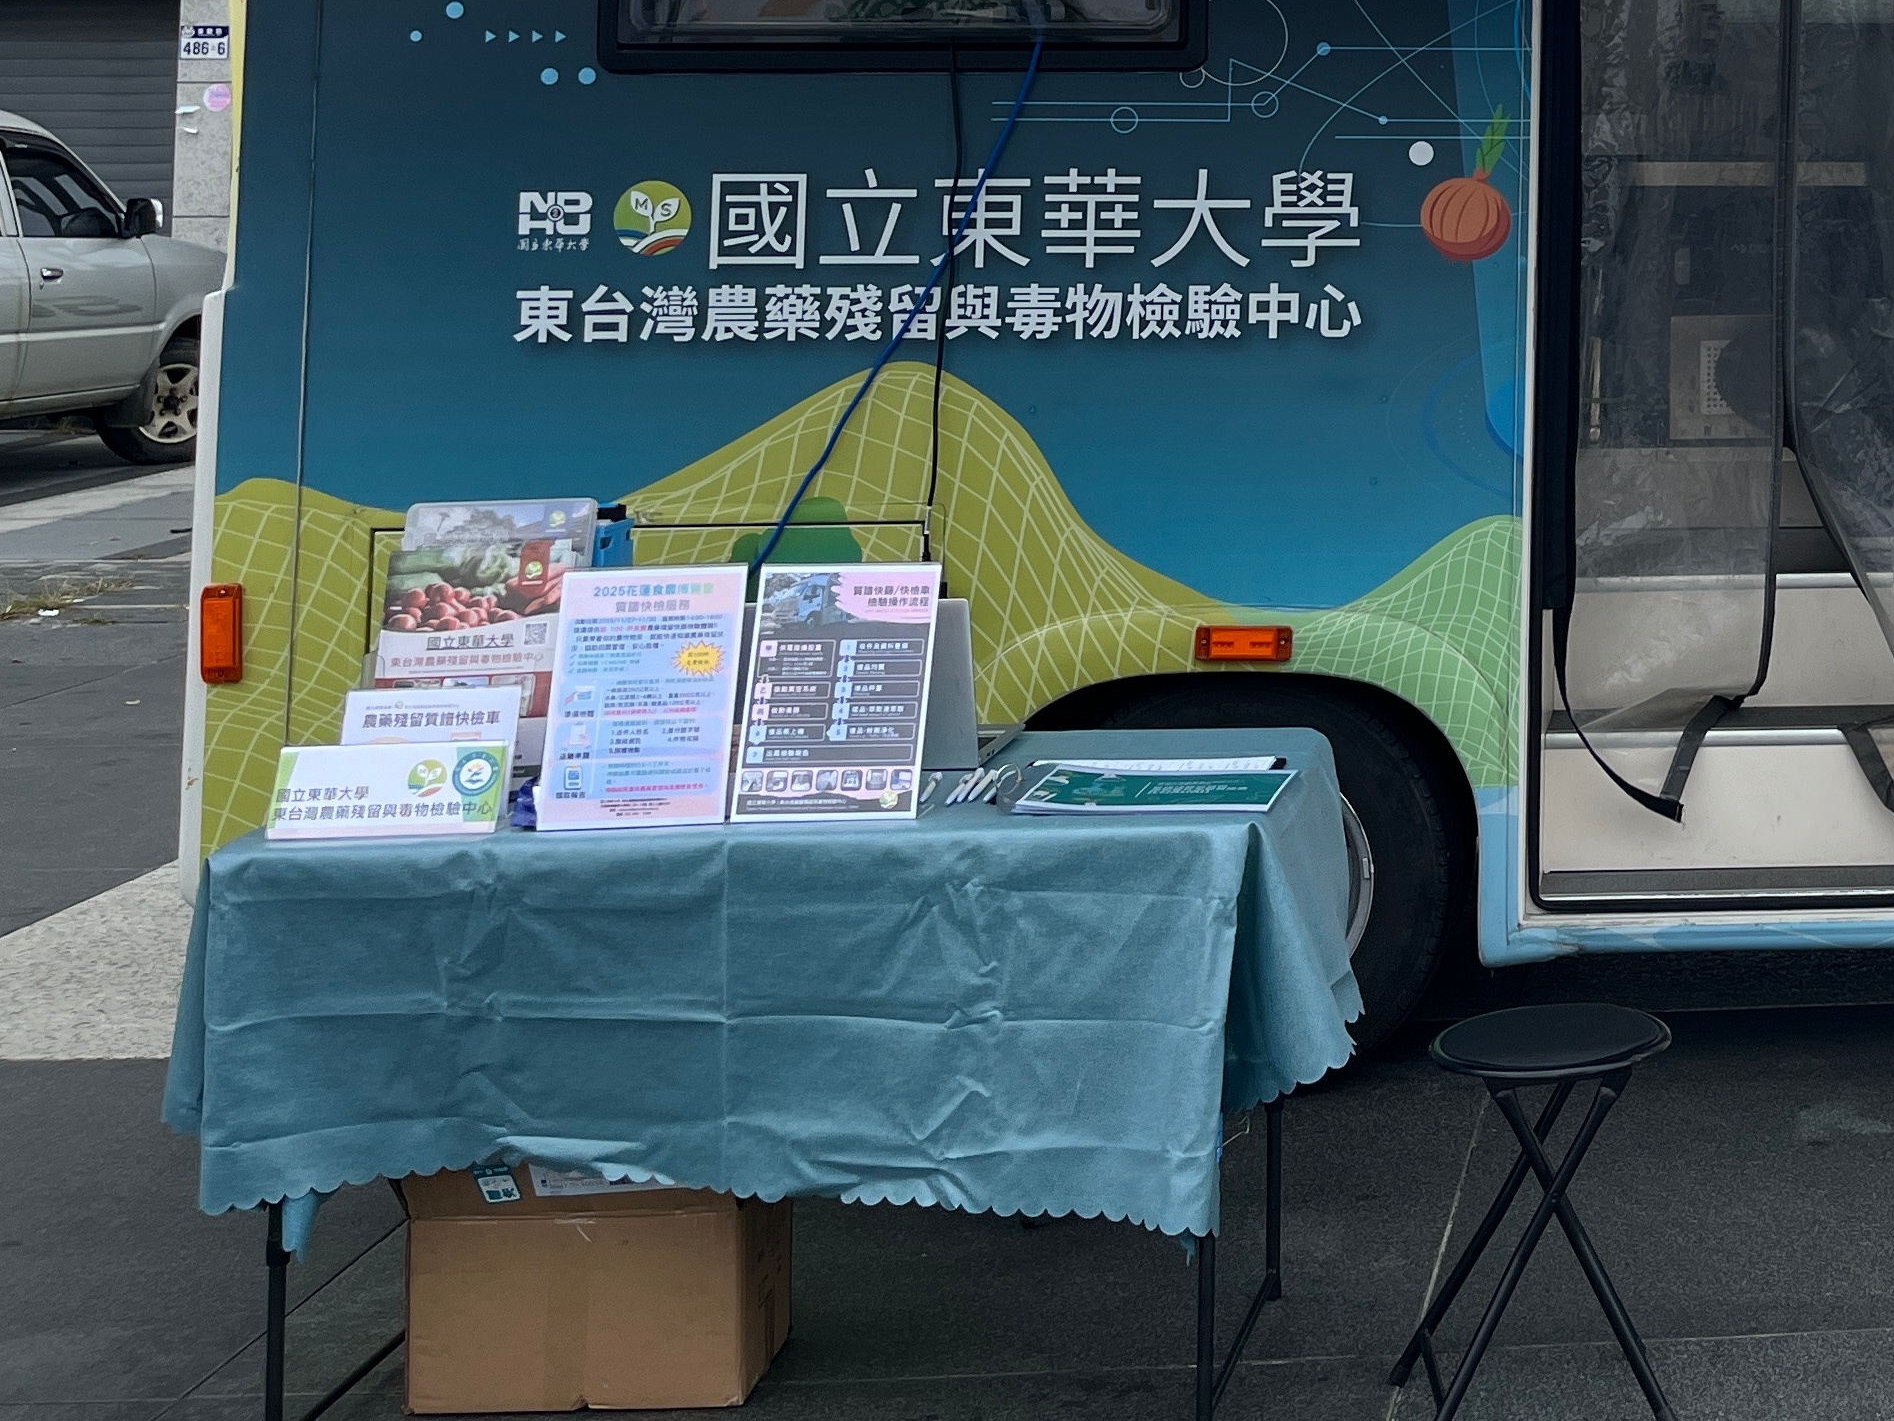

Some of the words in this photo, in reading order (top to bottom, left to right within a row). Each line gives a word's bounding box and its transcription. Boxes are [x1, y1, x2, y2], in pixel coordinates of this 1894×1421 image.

[708, 167, 1361, 271] 國立東華大學
[512, 282, 1364, 346] 東台灣農藥殘留與毒物檢驗中心
[271, 801, 493, 822] 東台灣農藥殘留與毒物檢驗中心
[276, 786, 370, 803] 國立東華大學
